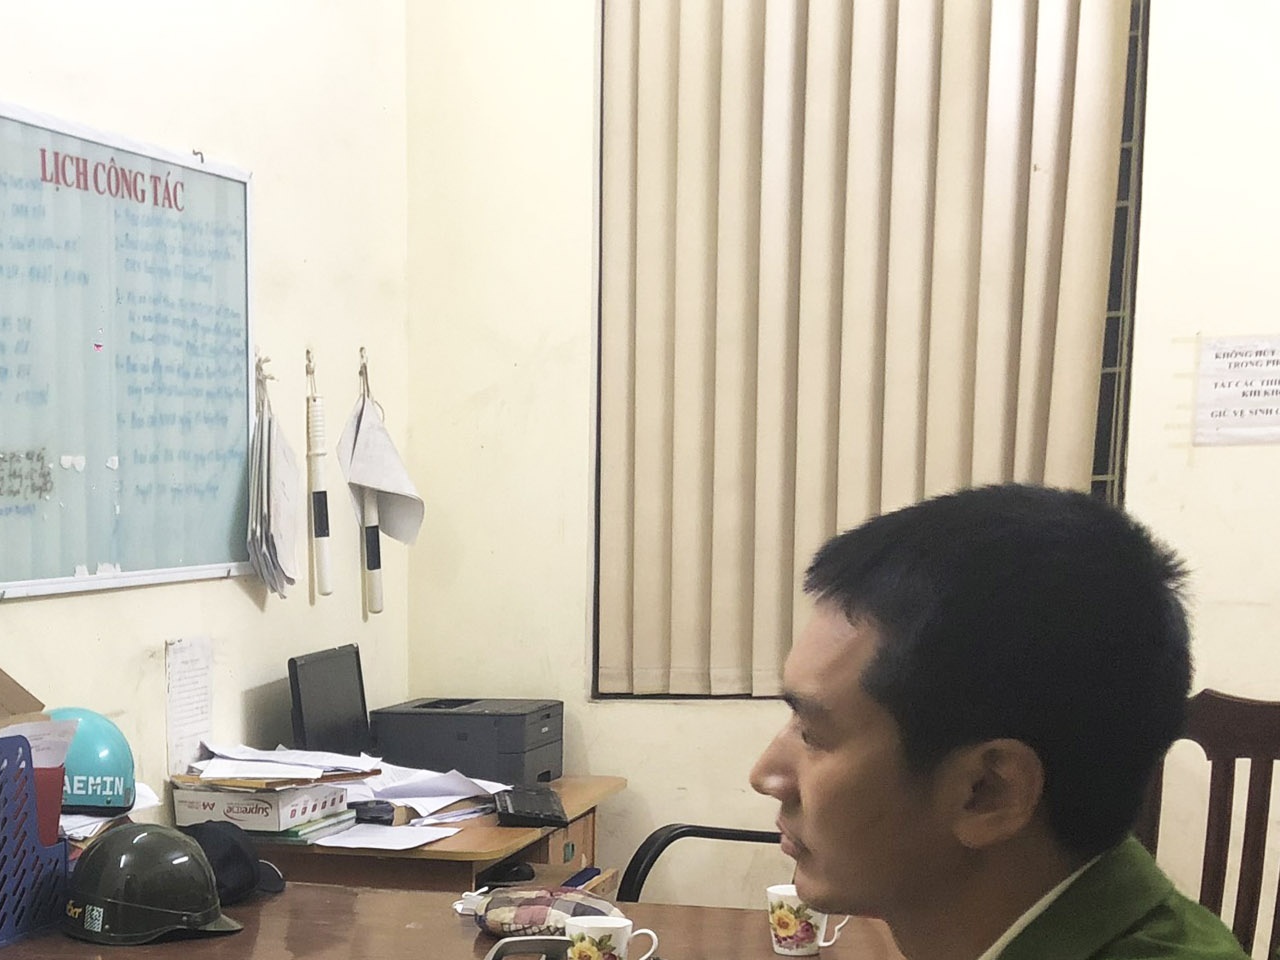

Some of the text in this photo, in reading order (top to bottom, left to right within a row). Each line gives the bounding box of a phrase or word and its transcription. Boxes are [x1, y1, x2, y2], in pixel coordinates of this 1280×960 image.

[39, 148, 89, 192] LỊCH
[93, 156, 146, 204] CÔNG
[150, 171, 185, 212] TÁC
[1228, 360, 1263, 370] TRONG
[63, 775, 124, 795] AEMIN
